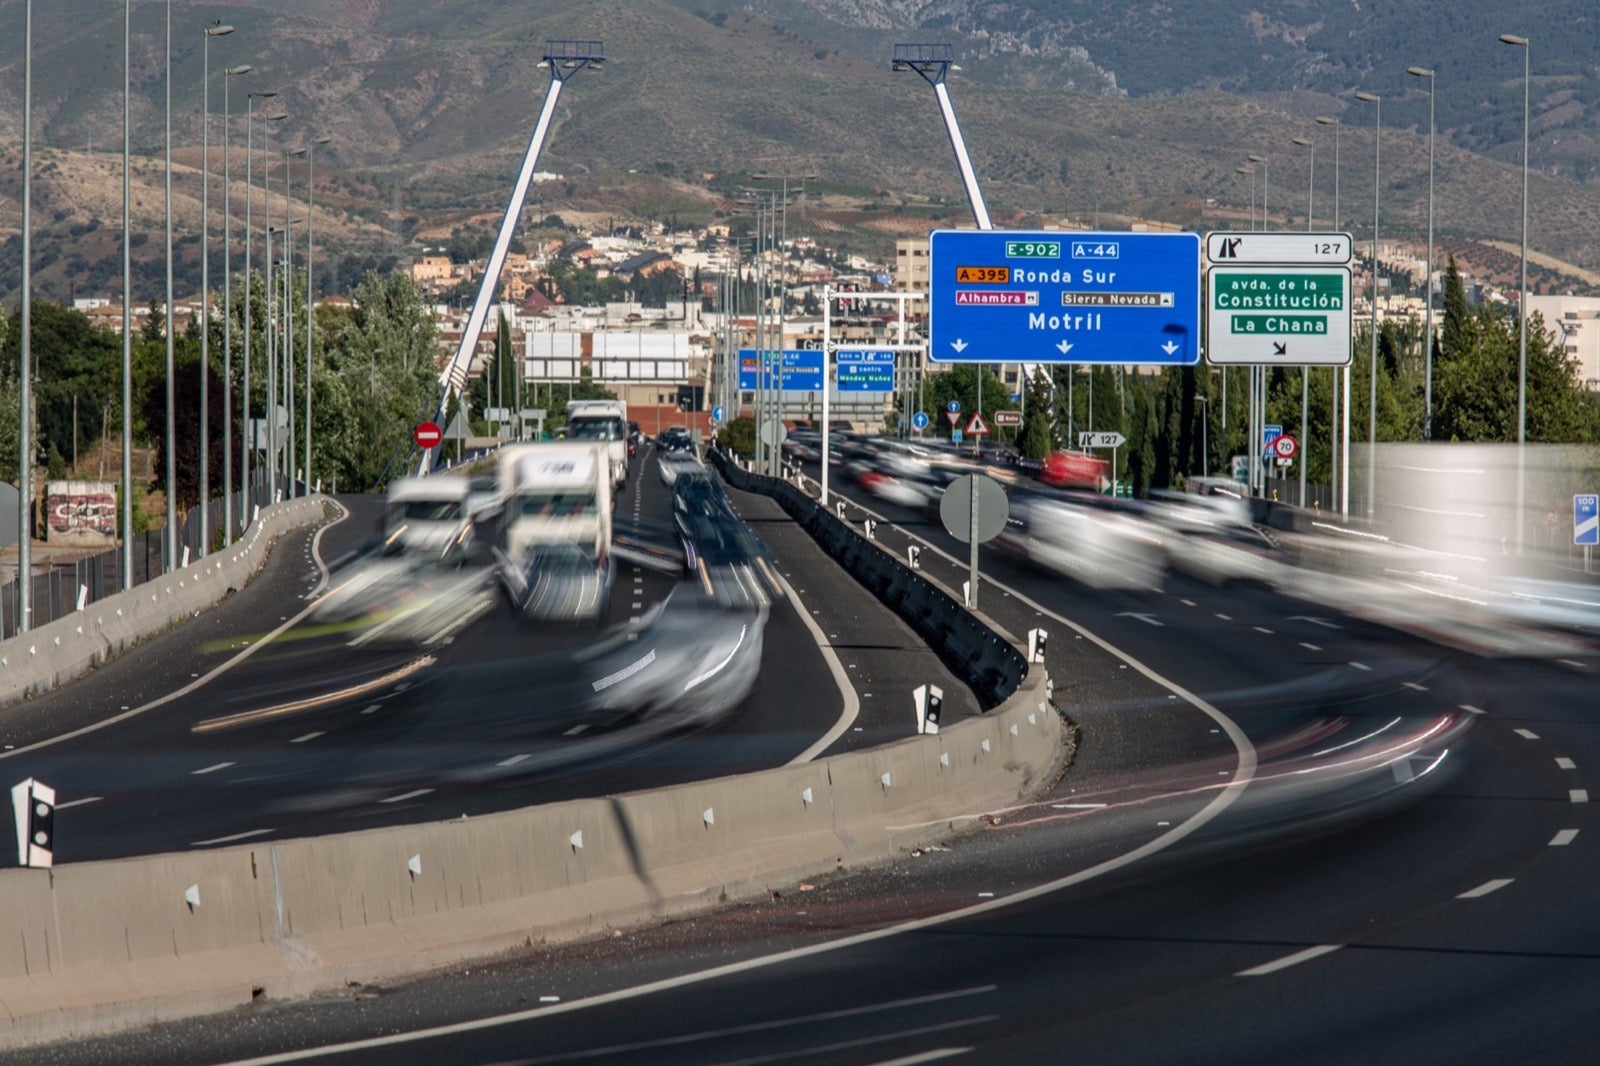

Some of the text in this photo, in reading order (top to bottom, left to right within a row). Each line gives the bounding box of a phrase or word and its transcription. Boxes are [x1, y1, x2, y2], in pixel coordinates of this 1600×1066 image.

[1008, 244, 1117, 256] E-902 A-44
[1314, 243, 1341, 254] 127
[960, 269, 1116, 283] A-395 Ronda Sur
[1231, 280, 1317, 290] avda. de la
[959, 293, 1021, 303] Alhambra
[1064, 294, 1156, 304] Sierra Nevada
[1218, 293, 1341, 307] Constitución
[1028, 313, 1102, 331] Motril
[1233, 318, 1325, 332] La Chana
[803, 340, 831, 350] Gra
[1101, 435, 1118, 445] 127
[1280, 442, 1292, 451] 70
[1580, 498, 1595, 506] 100
